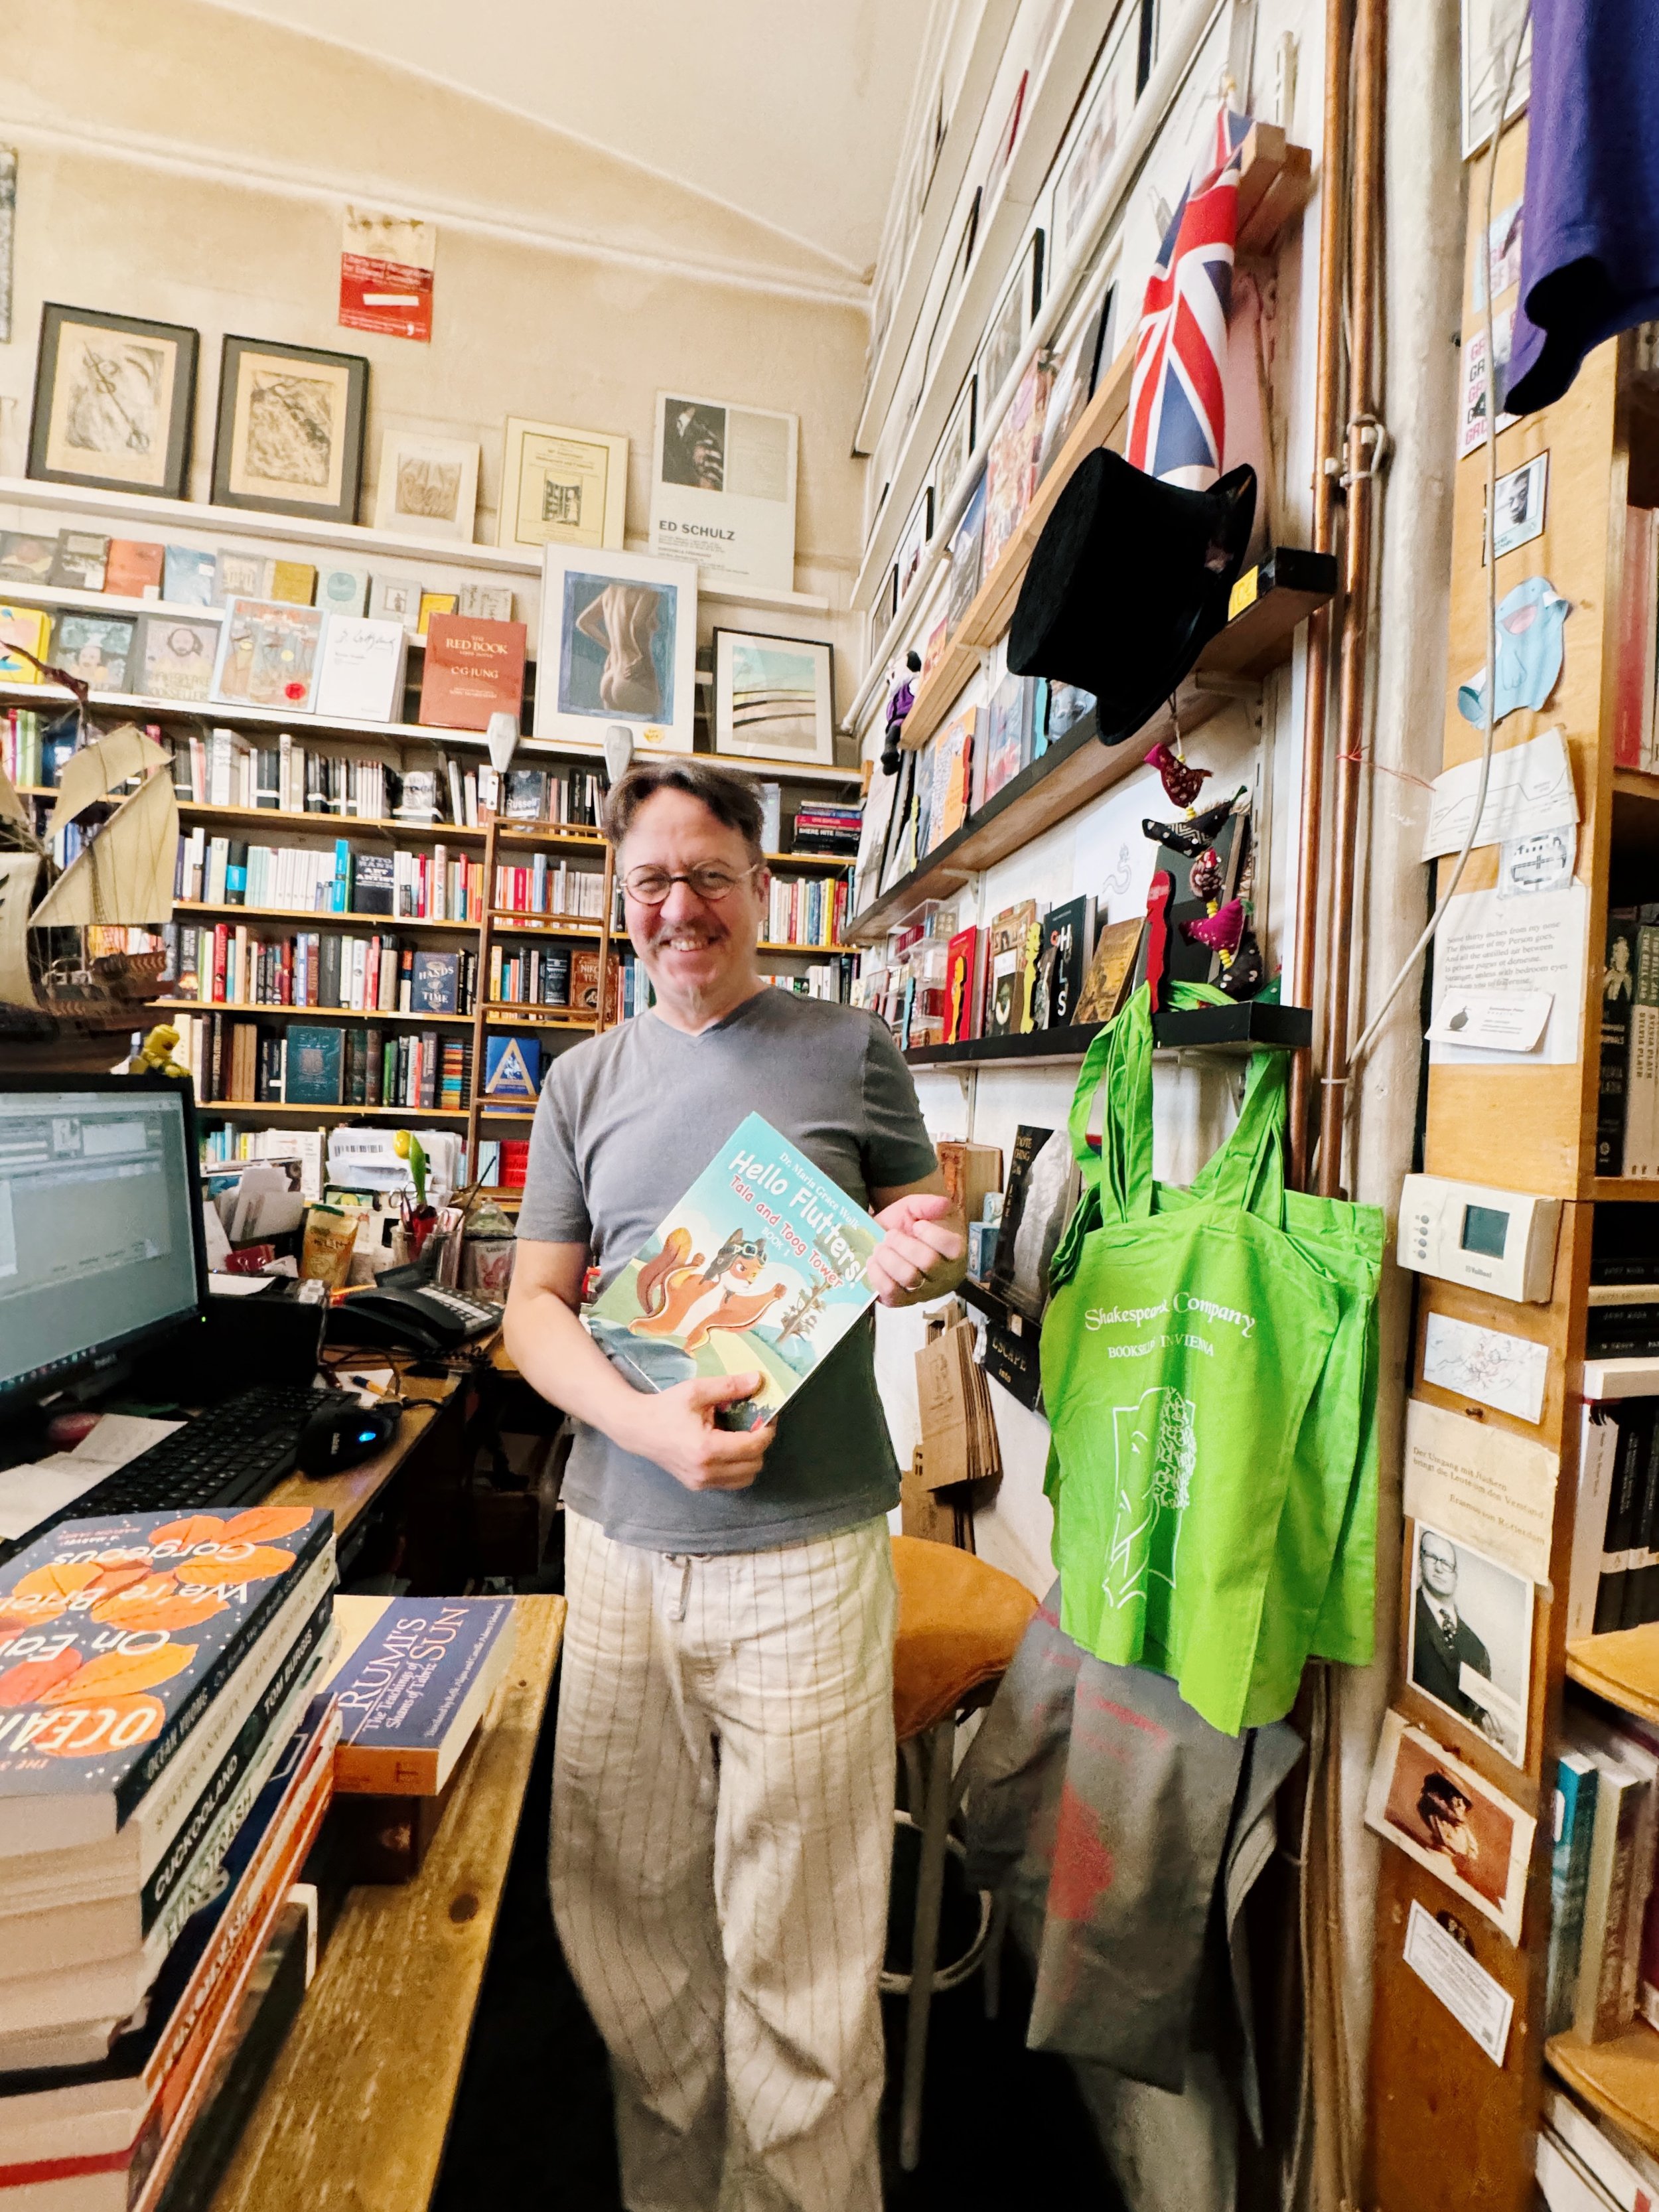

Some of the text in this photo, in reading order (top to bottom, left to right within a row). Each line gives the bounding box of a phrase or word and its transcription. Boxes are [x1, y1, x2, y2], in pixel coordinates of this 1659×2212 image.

[659, 520, 736, 541] ED SCHULZ
[446, 638, 508, 654] RED BOOK
[507, 798, 541, 809] Russell
[360, 855, 393, 863] OTTO
[1459, 942, 1485, 952] frontier
[1508, 936, 1533, 946] Person
[1535, 933, 1555, 943] goes,
[1465, 933, 1484, 942] thirty
[1486, 929, 1507, 938] inches
[1510, 925, 1527, 935] from
[1528, 924, 1540, 933] my
[1542, 921, 1561, 930] nose
[1445, 954, 1459, 963] And
[1470, 952, 1480, 960] the
[1482, 948, 1509, 958] untilled
[1522, 943, 1553, 954] between
[1640, 953, 1650, 977] BELL
[418, 966, 455, 980] HANDS
[1445, 973, 1474, 982] Stranger,
[1498, 968, 1513, 977] with
[1515, 964, 1549, 975] bedroom
[1550, 962, 1569, 972] eyes
[1452, 963, 1475, 974] private
[421, 991, 449, 1004] TIME
[1639, 980, 1649, 999] JAR
[1636, 1047, 1644, 1078] PLATH
[779, 1152, 860, 1230] Dr. Maria Grace Wolk
[728, 1150, 868, 1290] Hello Flutters!
[729, 1174, 845, 1290] Tala and Toog Tower
[760, 1226, 784, 1250] BOOK
[1173, 1291, 1256, 1339] Company
[992, 1337, 1027, 1372] ESCAPE
[1174, 1333, 1214, 1357] VIENNA
[999, 1366, 1012, 1383] into
[1413, 1447, 1427, 1457] Der
[1428, 1453, 1459, 1471] Umgang
[1461, 1467, 1474, 1477] mit
[1413, 1457, 1435, 1471] bringt
[1437, 1467, 1449, 1477] die
[1451, 1472, 1471, 1487] Leute
[1487, 1489, 1502, 1501] den
[1449, 1493, 1545, 1546] Erasmus von Rotterdam
[53, 1538, 256, 1566] Gorgeous
[119, 1582, 248, 1604] We're
[91, 1629, 171, 1657] On
[338, 1618, 427, 1712] RUMI'S
[409, 1606, 470, 1661] SUN
[362, 1660, 421, 1732] The Teachings of
[386, 1662, 438, 1730] Shams of Tabriz
[147, 1728, 178, 1781] OCEAN
[155, 1754, 238, 1902] CUCKOOLAND
[264, 1675, 283, 1716] TOM
[282, 1628, 313, 1681] BURGIS
